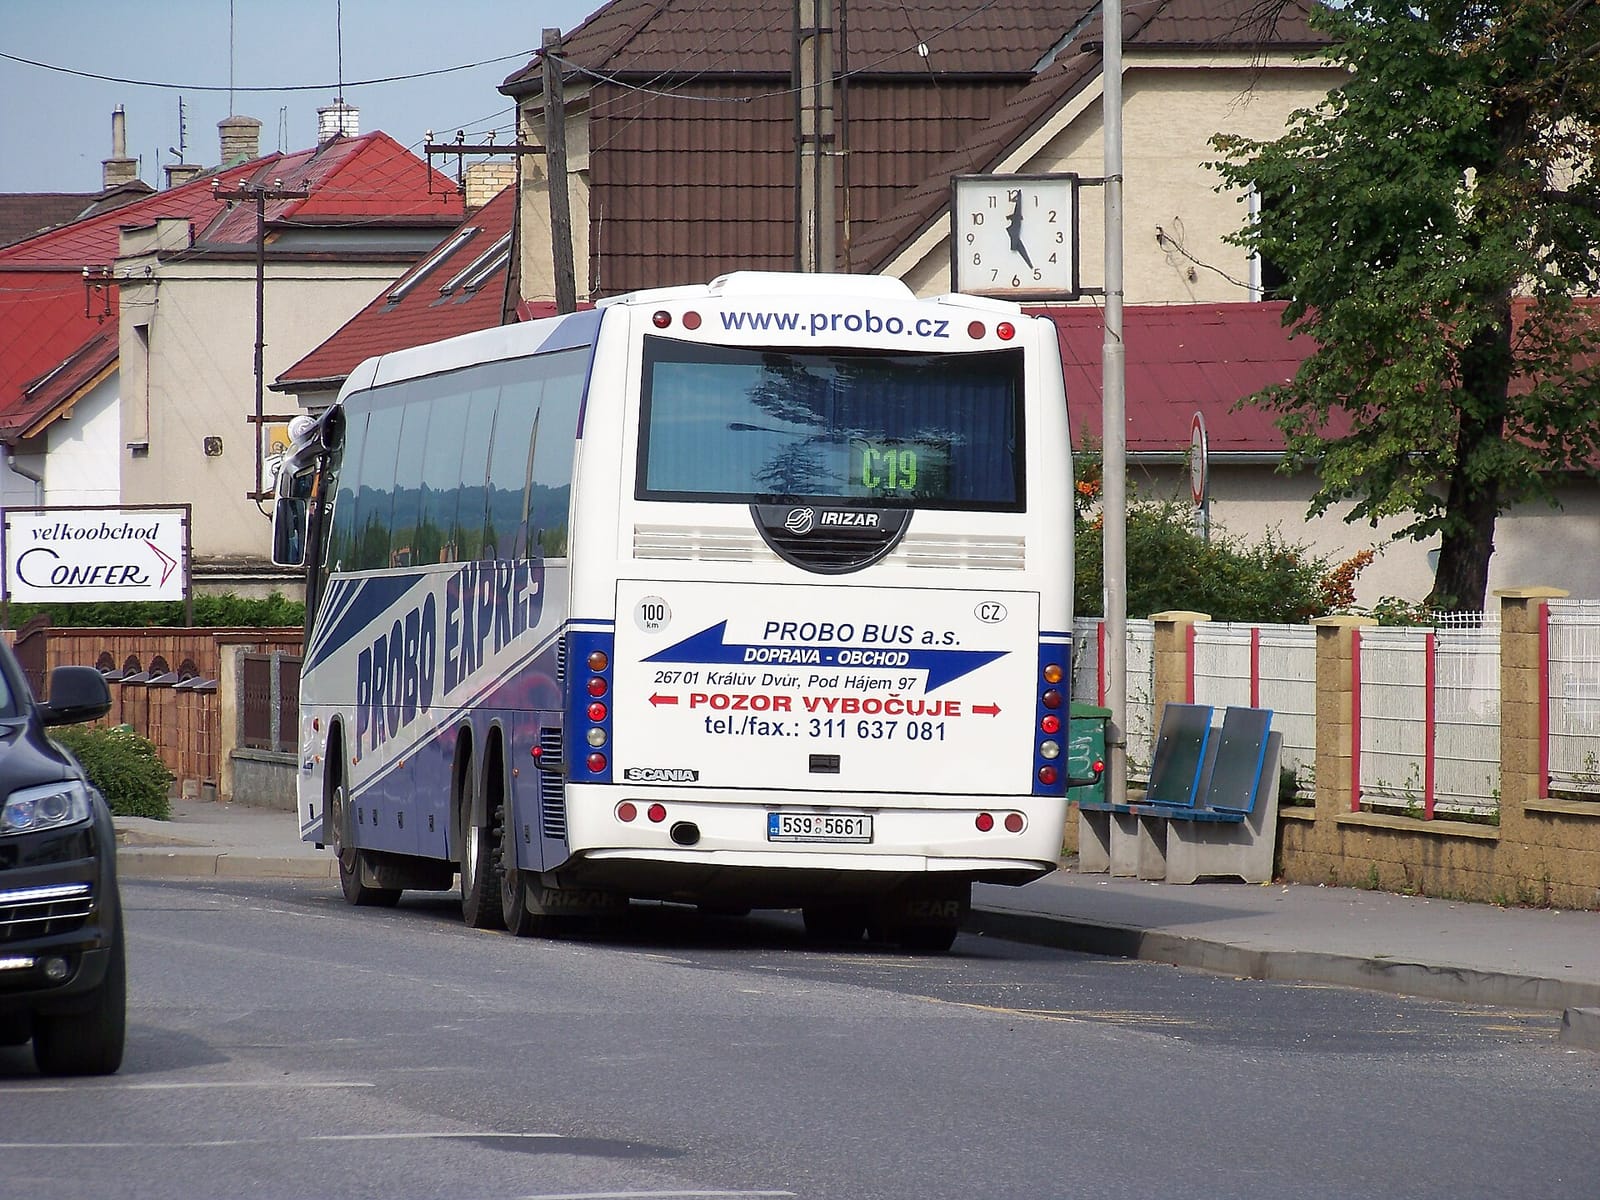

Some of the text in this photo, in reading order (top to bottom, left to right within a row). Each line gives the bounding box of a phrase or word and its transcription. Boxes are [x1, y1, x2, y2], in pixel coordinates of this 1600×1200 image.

[988, 195, 997, 209] 11
[1006, 189, 1021, 202] 12
[1033, 195, 1039, 208] 1
[971, 212, 984, 226] 10
[1048, 210, 1057, 223] 2
[966, 233, 975, 246] 9
[1055, 231, 1064, 244] 3
[973, 252, 982, 266] 8
[1048, 252, 1057, 265] 4
[990, 268, 999, 282] 7
[1011, 274, 1021, 288] 6
[1033, 268, 1042, 281] 5
[720, 309, 950, 338] www.probo.cz
[862, 448, 917, 490] C19
[820, 511, 880, 527] IRIZAR
[32, 522, 160, 541] velkoobchod
[16, 547, 152, 589] CONFER
[641, 604, 664, 621] 100
[981, 604, 1001, 621] CZ
[646, 621, 660, 629] km
[763, 621, 961, 646] PROBO BUS a.s.
[743, 648, 821, 664] DOPRAVA
[837, 651, 910, 666] OBCHOD
[356, 591, 437, 763] PROBO
[808, 675, 839, 688] Pod
[844, 675, 892, 693] Hájem
[897, 677, 918, 690] 97
[689, 693, 961, 717] POZOR VYBOČUJE
[705, 715, 945, 741] tel./fax.: 311 637 081
[628, 768, 696, 782] SCANIA
[783, 817, 812, 833] 5S9
[825, 818, 863, 835] 5661
